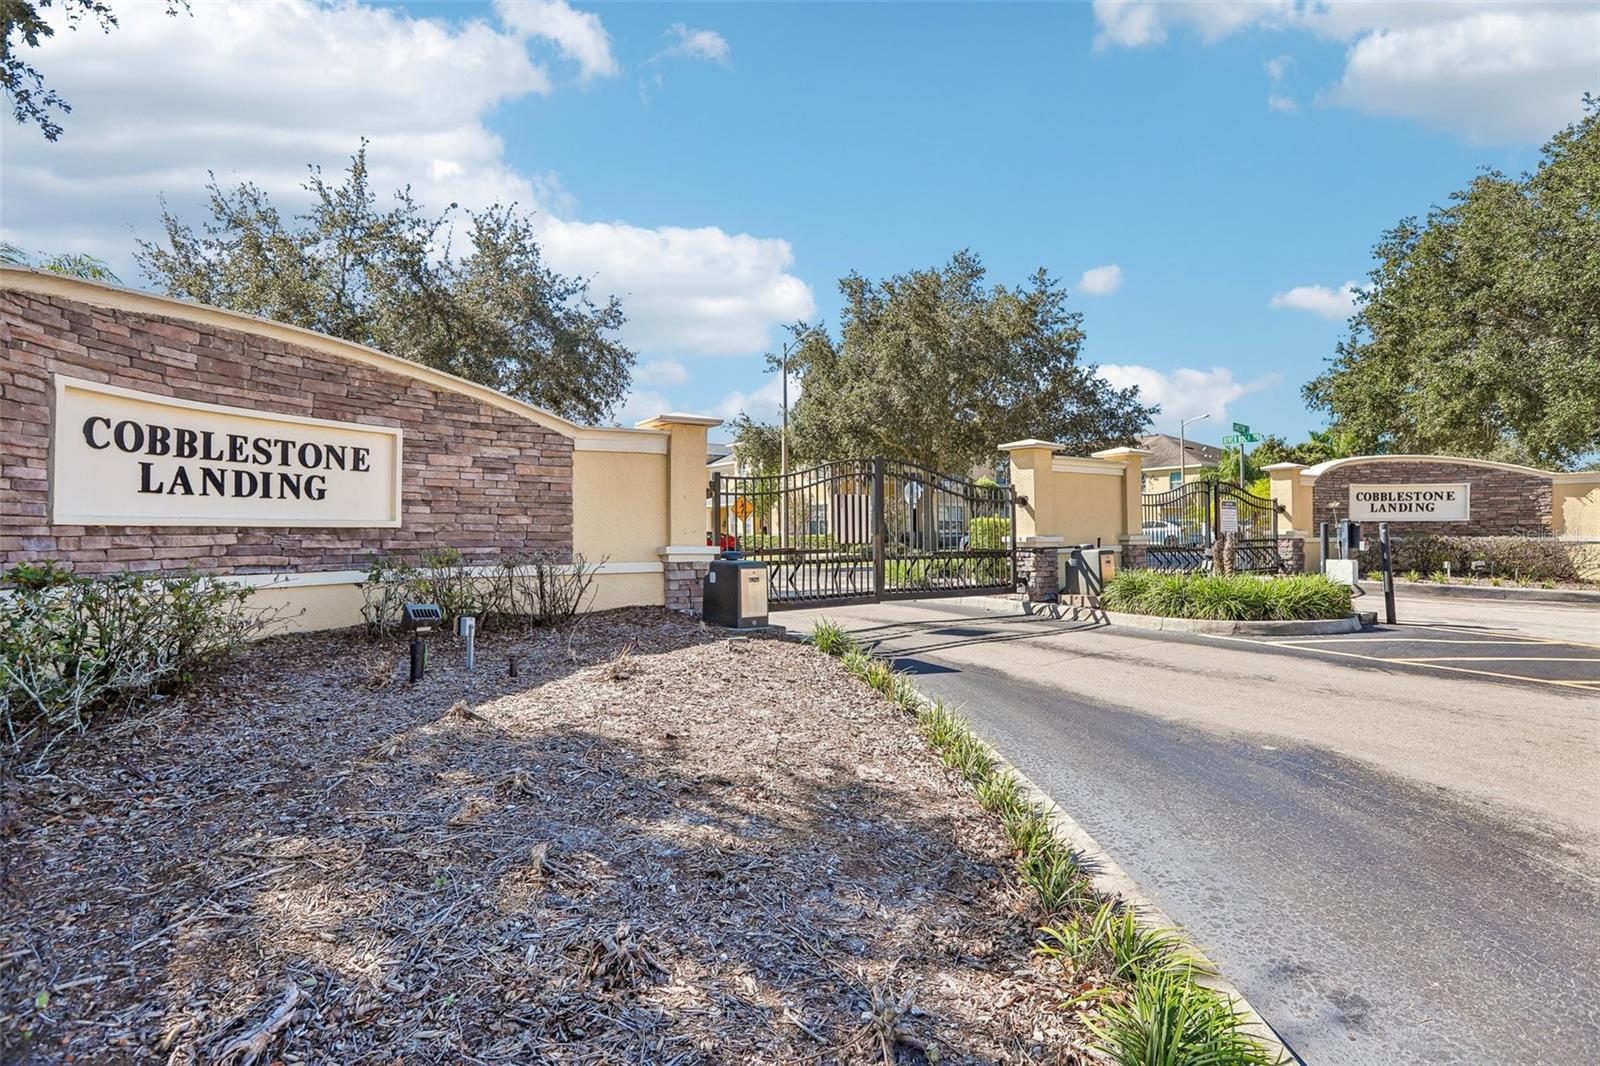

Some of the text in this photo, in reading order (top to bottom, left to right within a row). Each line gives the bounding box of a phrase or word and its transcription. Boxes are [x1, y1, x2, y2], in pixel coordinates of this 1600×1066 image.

[82, 416, 371, 473] COBBLESTONE
[137, 461, 328, 501] LANDING
[1355, 491, 1456, 502] COBBLESTONE
[1370, 502, 1436, 513] LANDING
